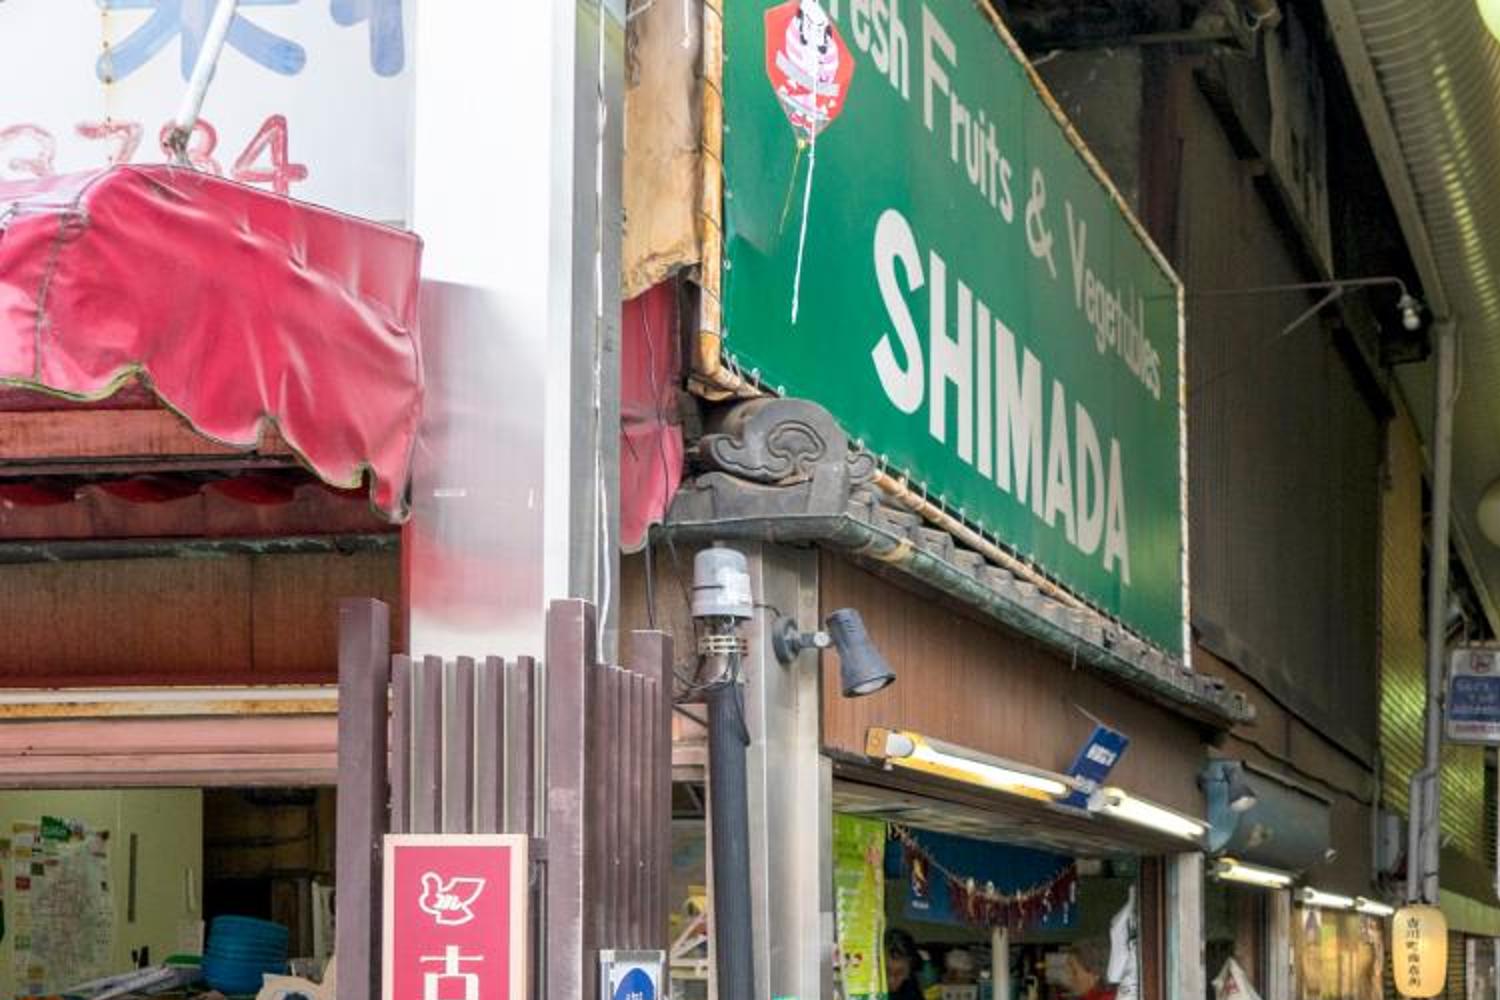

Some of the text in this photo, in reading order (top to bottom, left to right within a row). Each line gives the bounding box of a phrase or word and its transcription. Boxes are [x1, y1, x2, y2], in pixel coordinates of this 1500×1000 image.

[923, 3, 1013, 224] Fruits
[1025, 168, 1057, 279] &
[1065, 200, 1161, 401] Vegetables
[872, 208, 1130, 586] SHIMADA
